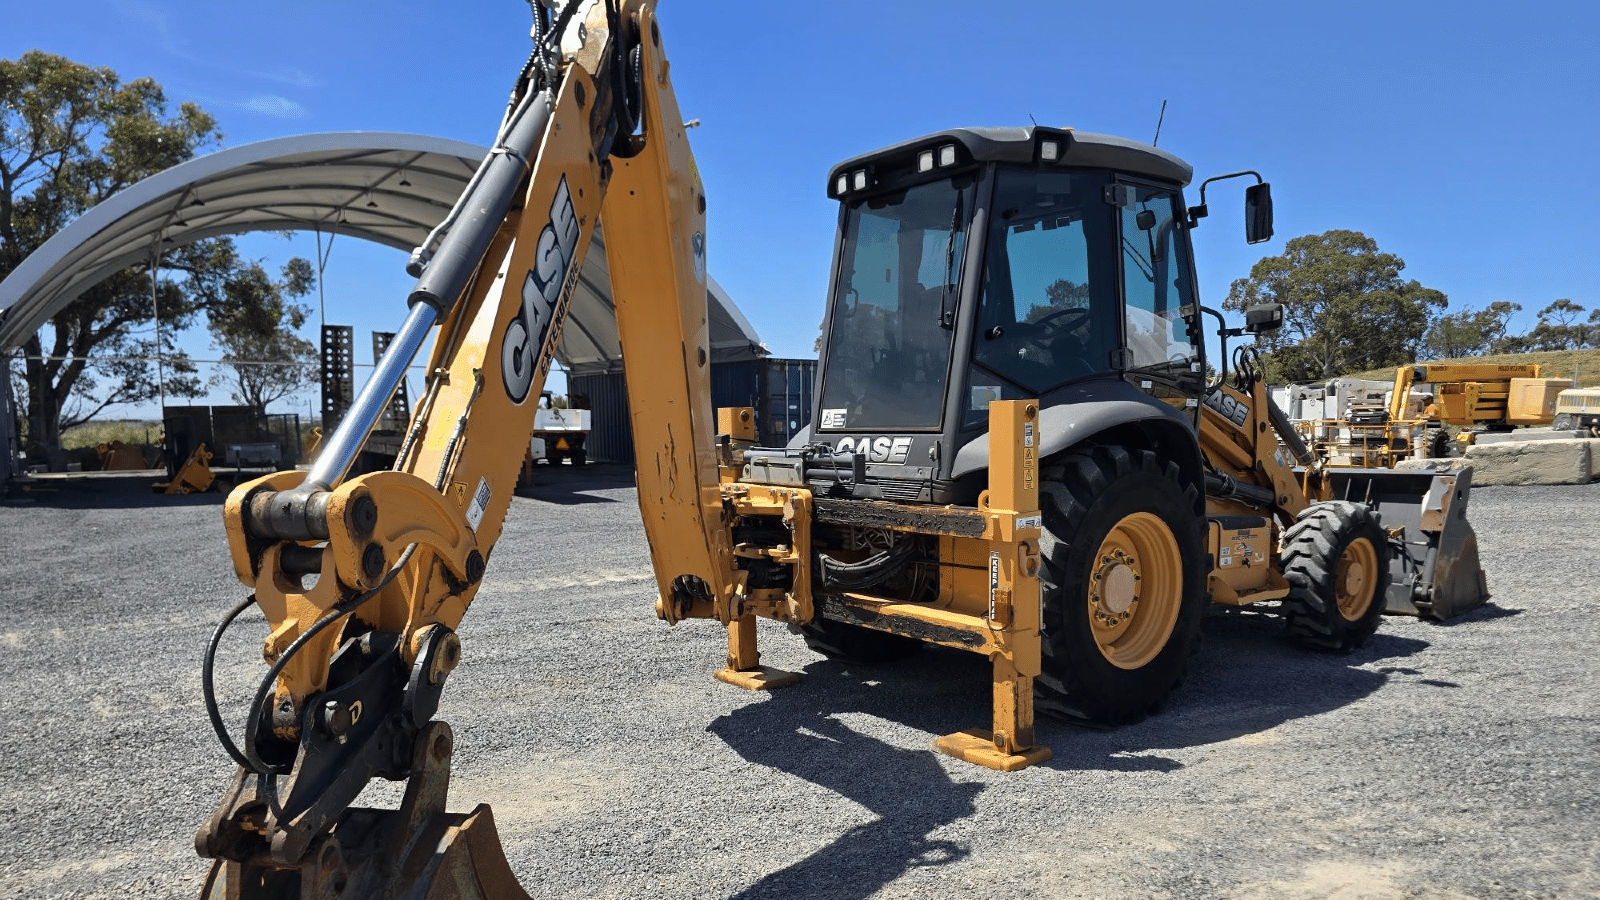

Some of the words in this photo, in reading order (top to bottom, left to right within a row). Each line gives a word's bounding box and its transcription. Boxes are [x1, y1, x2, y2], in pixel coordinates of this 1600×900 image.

[503, 174, 579, 403] CASE
[541, 257, 580, 376] EXTENDAHOE
[1203, 389, 1249, 426] ASE
[835, 436, 913, 463] CASE
